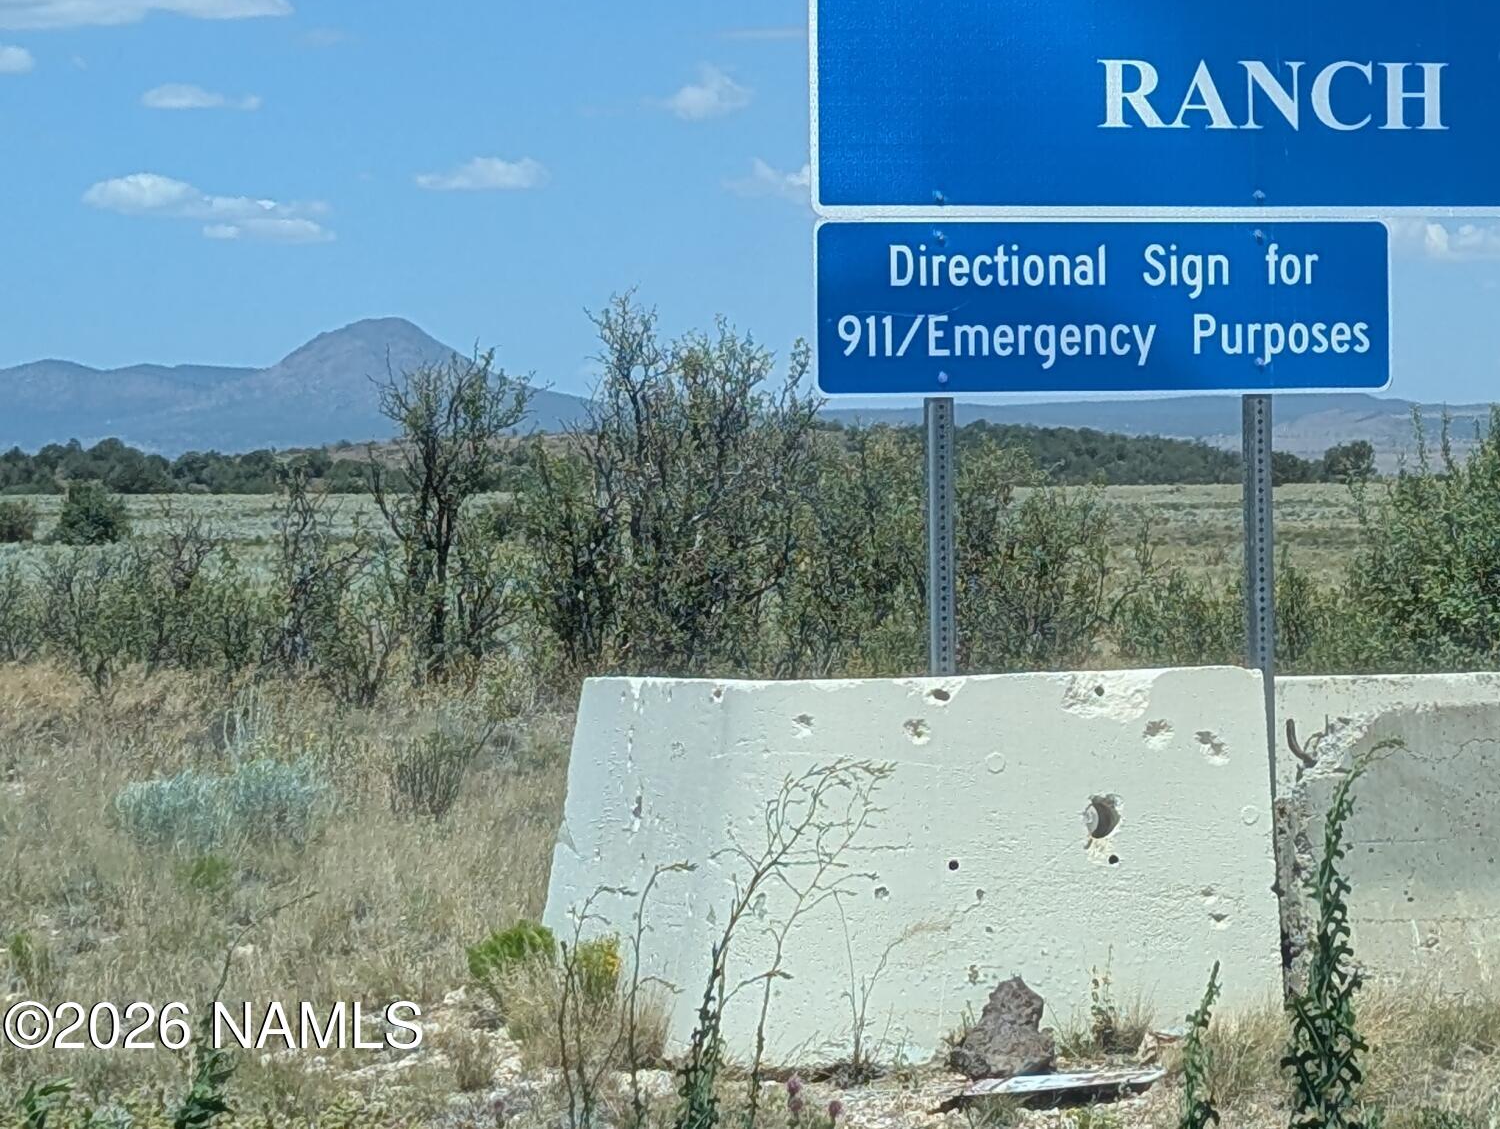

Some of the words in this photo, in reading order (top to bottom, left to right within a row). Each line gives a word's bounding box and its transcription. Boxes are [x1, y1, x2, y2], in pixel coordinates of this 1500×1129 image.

[1098, 59, 1448, 131] RANCH
[890, 244, 1106, 286] Directional
[1143, 244, 1229, 299] Sign
[1265, 243, 1319, 285] for
[838, 314, 1156, 369] 911/Emergency
[1193, 313, 1370, 365] Purposes
